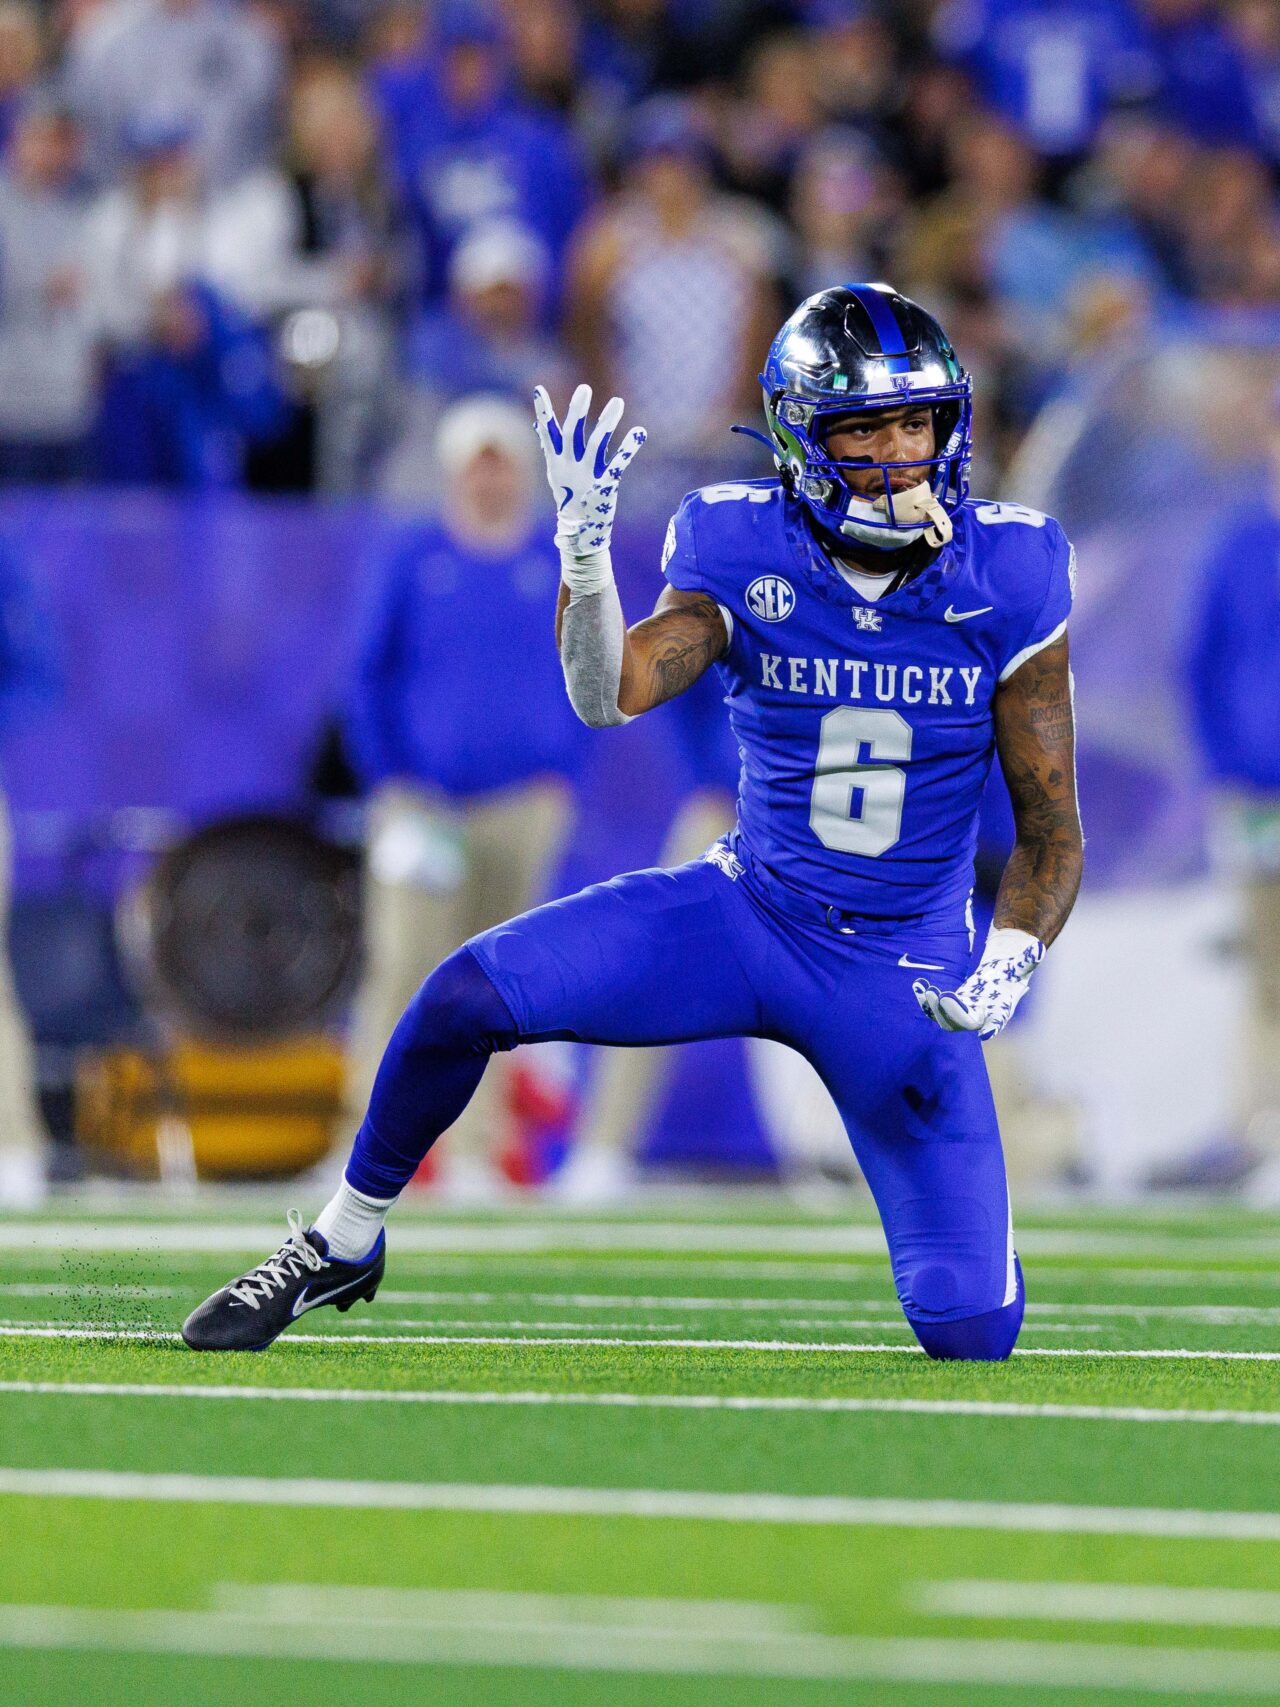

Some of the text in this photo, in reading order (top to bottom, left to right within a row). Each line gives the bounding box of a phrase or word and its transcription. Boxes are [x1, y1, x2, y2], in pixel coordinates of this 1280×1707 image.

[938, 432, 962, 473] Rdell
[749, 578, 792, 620] SEC
[851, 605, 883, 632] UK
[760, 652, 982, 706] KENTUCKY
[809, 705, 913, 858] 6
